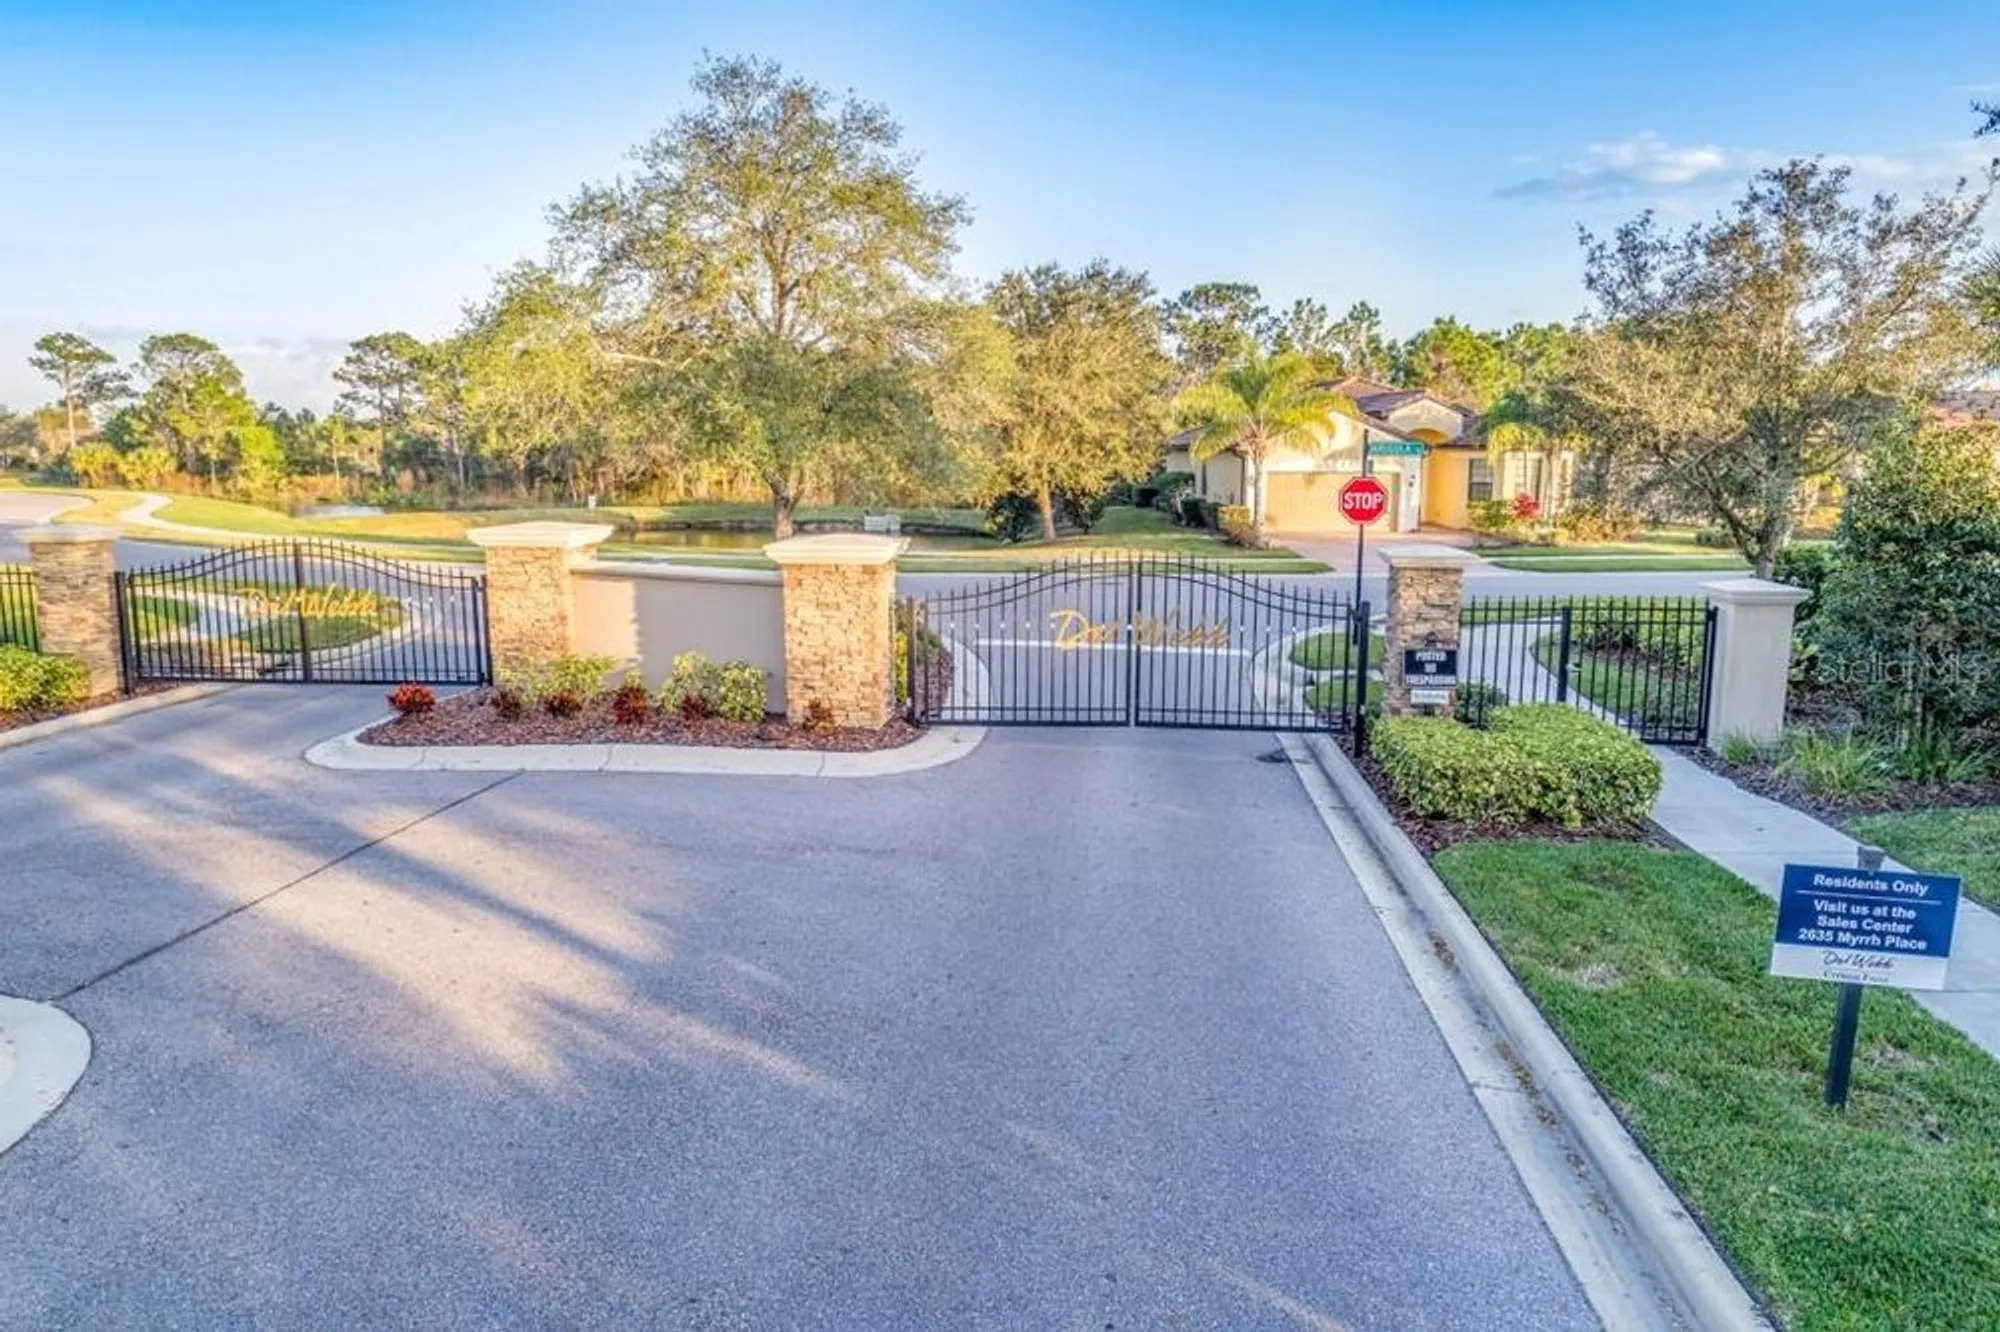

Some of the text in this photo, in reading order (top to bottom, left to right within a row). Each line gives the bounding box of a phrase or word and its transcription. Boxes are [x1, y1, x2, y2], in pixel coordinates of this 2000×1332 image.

[1343, 492, 1383, 509] STOP
[1813, 874, 1929, 897] Residents Only
[1814, 899, 1916, 919] Visit us at the
[1817, 915, 1913, 934] Sales Center
[1798, 928, 1927, 950] 2635 Myrrh Place
